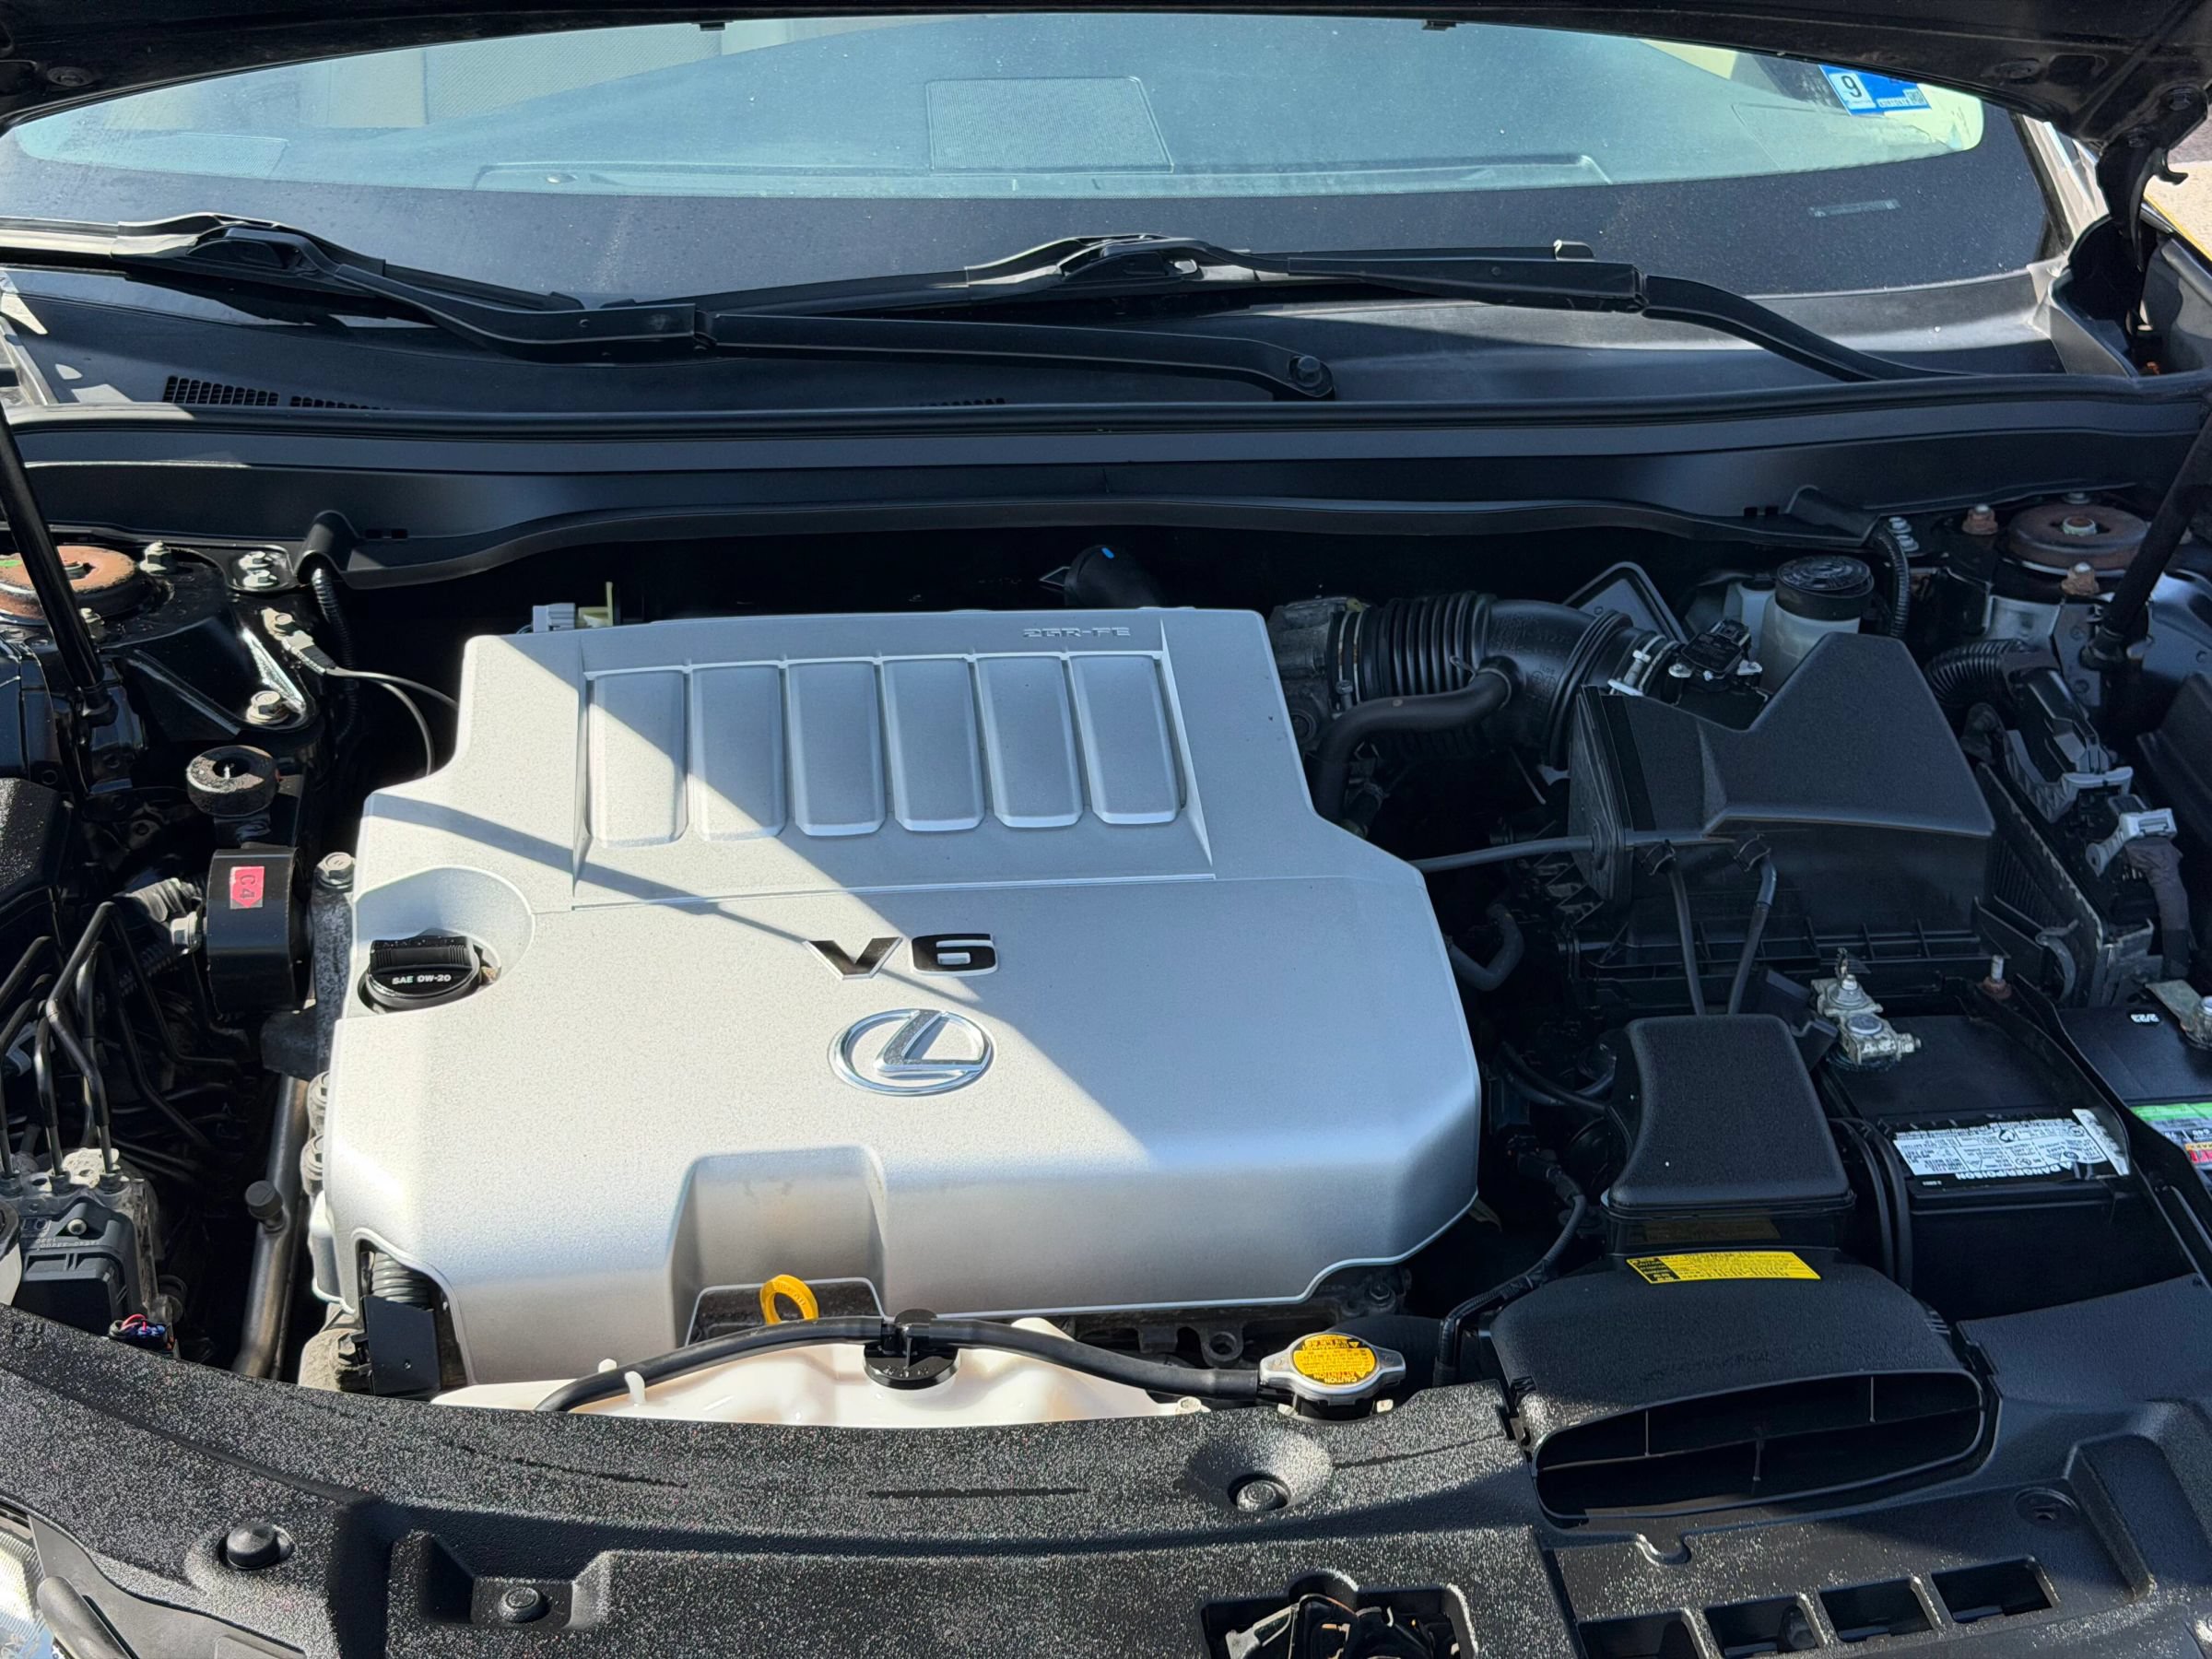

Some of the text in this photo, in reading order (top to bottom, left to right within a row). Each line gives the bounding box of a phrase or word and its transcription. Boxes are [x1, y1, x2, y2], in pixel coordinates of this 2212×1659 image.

[1841, 75, 1862, 99] 9
[1022, 626, 1131, 638] 2GR-FE
[802, 933, 998, 980] V6
[392, 974, 452, 985] SAE 0W-20
[1955, 1165, 2061, 1181] DANGER/POISON
